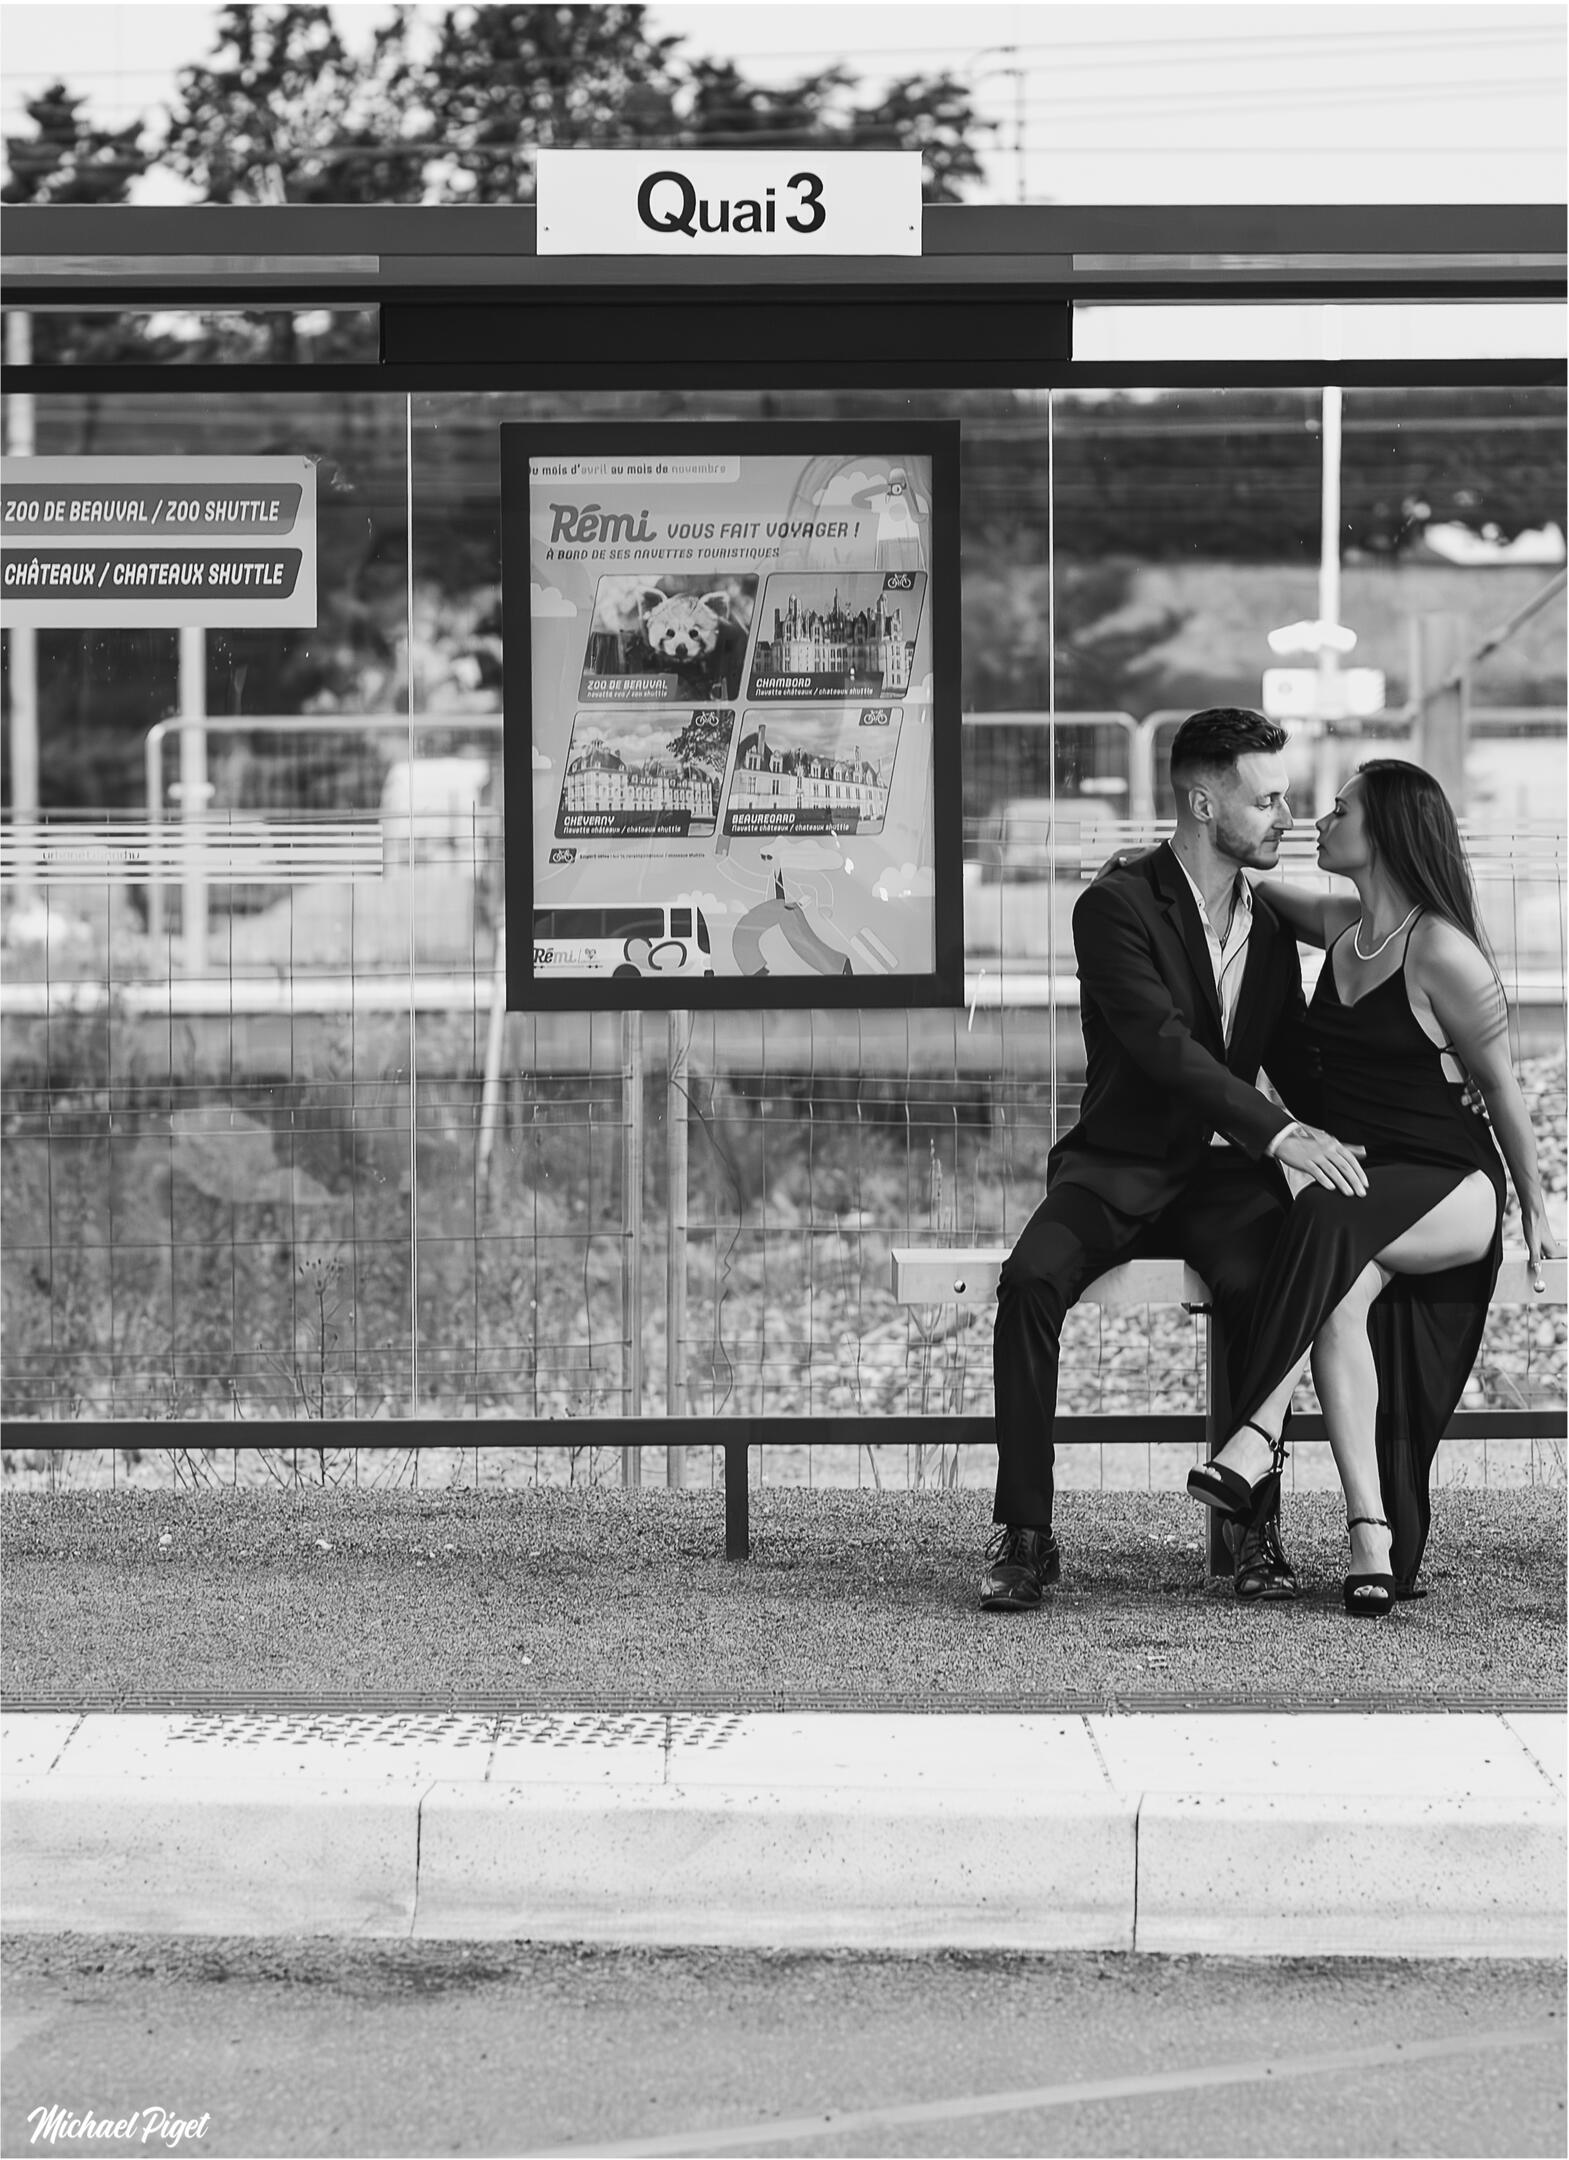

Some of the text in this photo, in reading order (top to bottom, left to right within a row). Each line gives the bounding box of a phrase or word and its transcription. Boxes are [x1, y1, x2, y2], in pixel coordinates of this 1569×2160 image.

[637, 171, 826, 238] Quai 3
[542, 463, 568, 476] mois
[570, 463, 607, 475] d'avril
[611, 465, 624, 475] au
[627, 463, 653, 475] mois
[655, 463, 669, 474] de
[671, 463, 726, 474] novembre
[5, 499, 281, 525] ZOO DE BEAUVAL / ZOO SHUTTLE
[549, 503, 861, 543] Rémi VOUS FAIT VOYAGER !
[546, 547, 780, 560] À BORD DE SES NAVETTES TOURISTIQUES
[4, 557, 285, 588] CHÂTEAUX / CHATEAUX SHUTTLE
[587, 680, 668, 690] ZOO DE BEAUVAL
[755, 678, 812, 688] CHAMBORD
[848, 687, 874, 696] shuttle
[563, 815, 615, 826] CHEVERNY
[731, 813, 796, 824] BEAUREGARD
[657, 825, 682, 833] shuttle
[534, 947, 577, 963] Rémi
